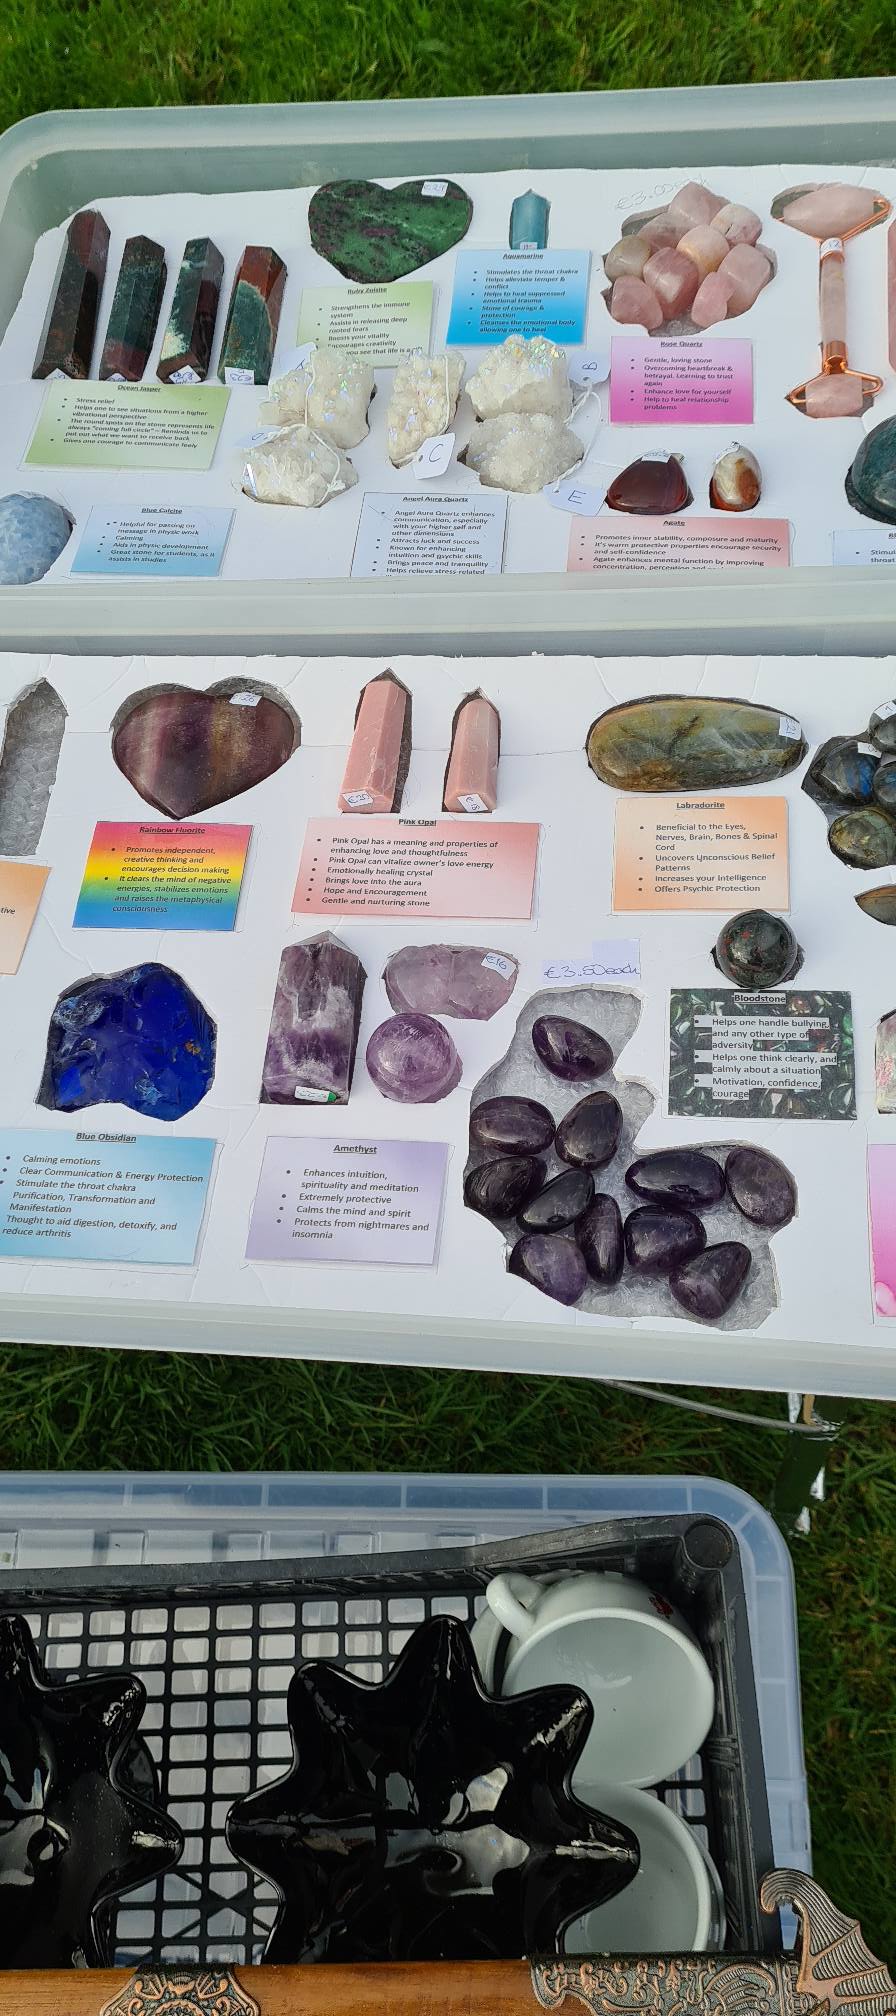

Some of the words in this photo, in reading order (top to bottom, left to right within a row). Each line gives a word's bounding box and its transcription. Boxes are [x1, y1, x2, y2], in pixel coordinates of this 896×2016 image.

[446, 840, 488, 848] properties
[718, 874, 766, 882] Intelligence
[324, 887, 345, 895] Hope
[364, 888, 427, 897] Encouragement
[683, 885, 713, 893] Psychic
[368, 898, 405, 907] nurturing
[734, 994, 786, 1003] Bloodstone
[713, 1018, 737, 1026] Helps
[792, 1019, 829, 1028] bullying,
[732, 1031, 747, 1039] any
[712, 1041, 753, 1050] adversity
[760, 1054, 782, 1062] think
[785, 1055, 817, 1064] clearly,
[713, 1078, 765, 1087] Motivation,
[768, 1079, 820, 1088] confidence,
[712, 1091, 749, 1099] courage
[76, 1133, 95, 1141] Blue
[98, 1134, 137, 1143] Obsidian
[333, 1145, 377, 1154] Amethyst
[23, 1155, 57, 1164] Calming
[60, 1157, 100, 1165] emotions
[20, 1167, 42, 1175] Clear
[44, 1168, 113, 1178] Communication
[125, 1172, 155, 1181] Energy
[157, 1173, 203, 1182] Protection
[304, 1169, 345, 1177] Enhances
[348, 1170, 387, 1180] intuition,
[16, 1179, 58, 1188] Stimulate
[60, 1181, 75, 1189] the
[77, 1182, 105, 1190] throat
[107, 1183, 136, 1192] chakra
[301, 1181, 348, 1190] spirituality
[370, 1184, 419, 1192] meditation
[13, 1192, 65, 1201] Purification,
[69, 1194, 136, 1204] Transformation
[139, 1197, 155, 1205] and
[299, 1193, 343, 1203] Extremely
[346, 1195, 391, 1204] protective
[10, 1203, 71, 1213] Manifestation
[297, 1206, 324, 1214] Calms
[326, 1207, 341, 1215] the
[343, 1208, 366, 1216] mind
[388, 1209, 411, 1218] spirit
[294, 1218, 331, 1227] Protects
[359, 1220, 409, 1230] nightmares
[412, 1223, 429, 1231] and
[292, 1230, 332, 1239] insomnia
